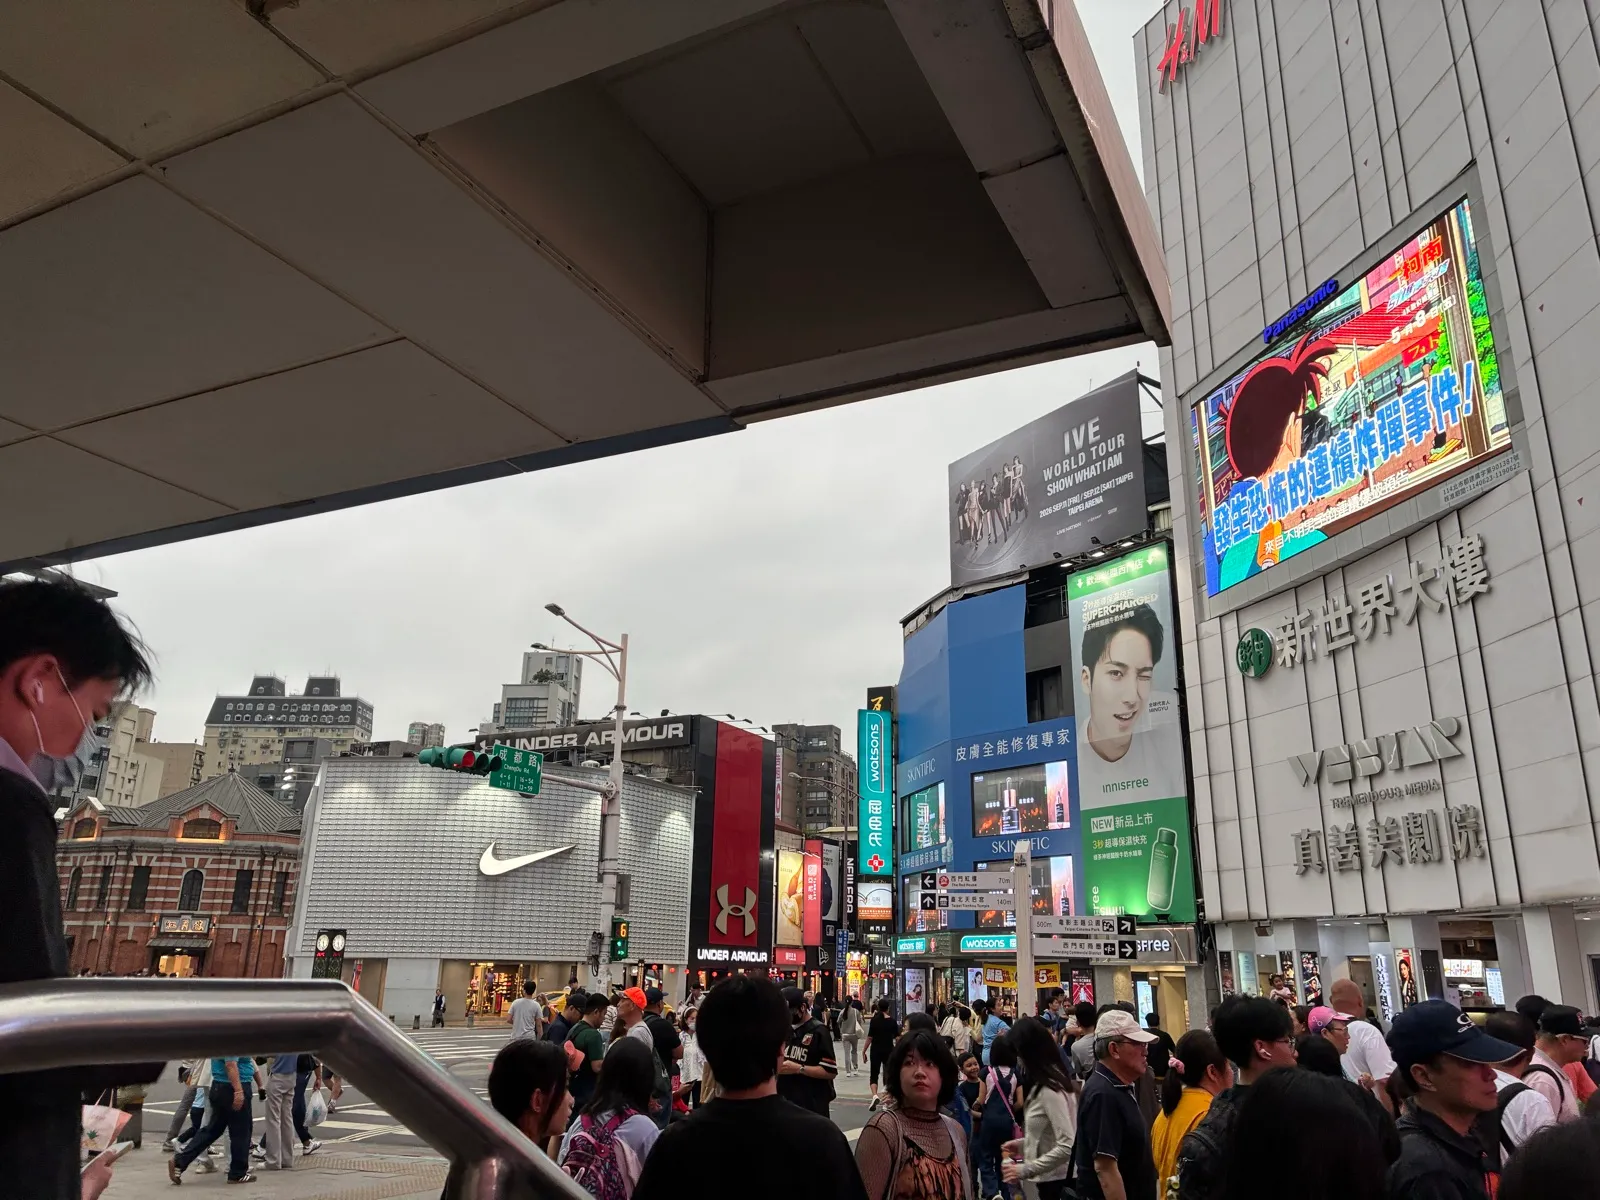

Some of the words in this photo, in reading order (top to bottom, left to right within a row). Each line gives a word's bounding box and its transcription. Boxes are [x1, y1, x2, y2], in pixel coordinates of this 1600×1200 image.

[1156, 0, 1222, 95] H&M
[1263, 278, 1338, 344] Panasonic
[1063, 416, 1101, 455] IVE
[1042, 452, 1086, 482] WORLD
[1090, 433, 1125, 461] TOUR
[1046, 474, 1074, 497] SHOW
[1074, 462, 1102, 485] WHAT
[1102, 460, 1107, 476] I
[1107, 452, 1123, 474] AM
[1039, 506, 1053, 518] 2026
[1115, 471, 1134, 486] TAIPEI
[1067, 505, 1085, 516] TAIPEI
[1085, 495, 1104, 509] ARENA
[1082, 593, 1159, 623] SUPERCHARGED
[1275, 533, 1490, 669] 新世界大樓
[506, 733, 578, 751] UNDER
[585, 722, 684, 747] ARMOUR
[955, 728, 1070, 762] 皮膚全能修復專家
[500, 748, 537, 768] 成都路
[869, 723, 879, 782] watsons
[907, 758, 936, 783] SKINTIFIC
[1404, 778, 1441, 796] MEDIA
[868, 799, 882, 847] 屈臣氏
[1092, 816, 1113, 831] NEW
[1115, 812, 1153, 829] 新品上市
[991, 836, 1050, 854] SKINFIC
[1290, 803, 1486, 876] 真善美劇院
[620, 923, 627, 938] 6
[965, 939, 1005, 948] watsons
[697, 948, 729, 961] UNDER
[730, 951, 768, 963] ARMOUR
